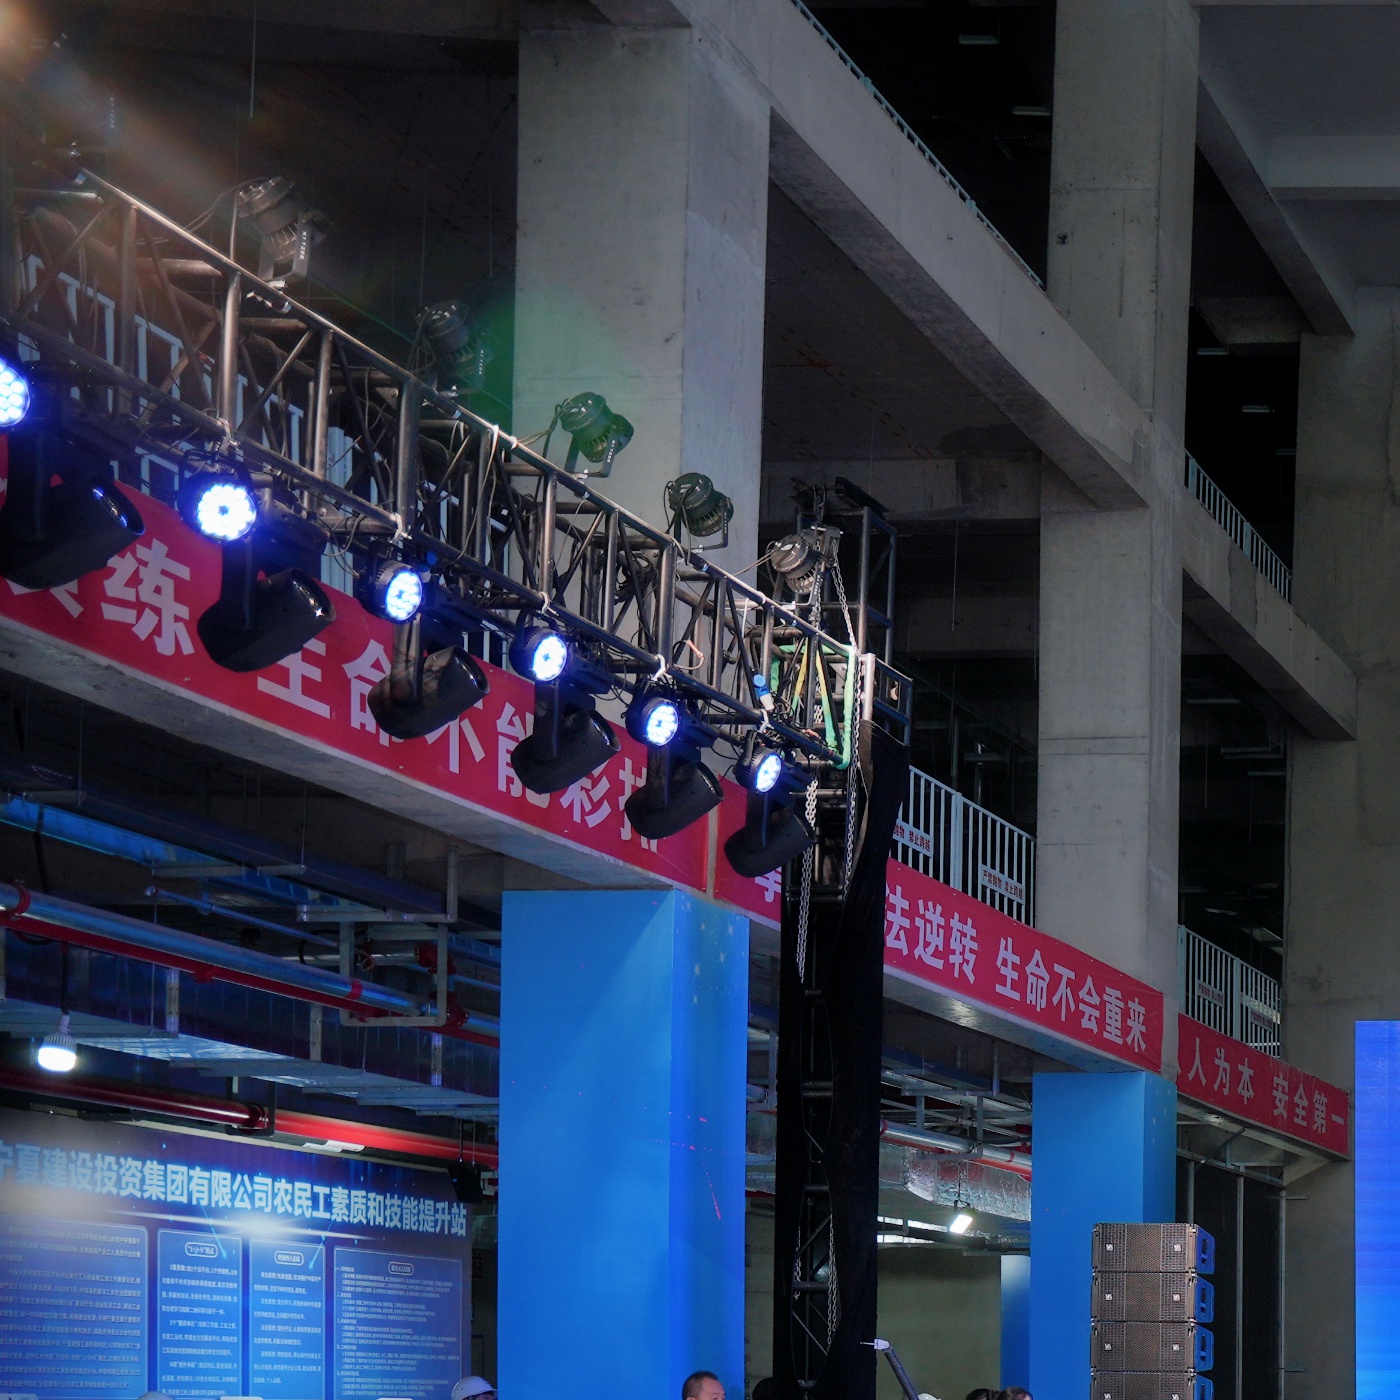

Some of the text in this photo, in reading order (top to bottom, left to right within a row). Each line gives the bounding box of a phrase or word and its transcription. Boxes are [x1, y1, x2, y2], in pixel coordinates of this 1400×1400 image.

[995, 937, 1147, 1053] 生命不会重来
[1177, 1037, 1345, 1134] 人为本 安全第一
